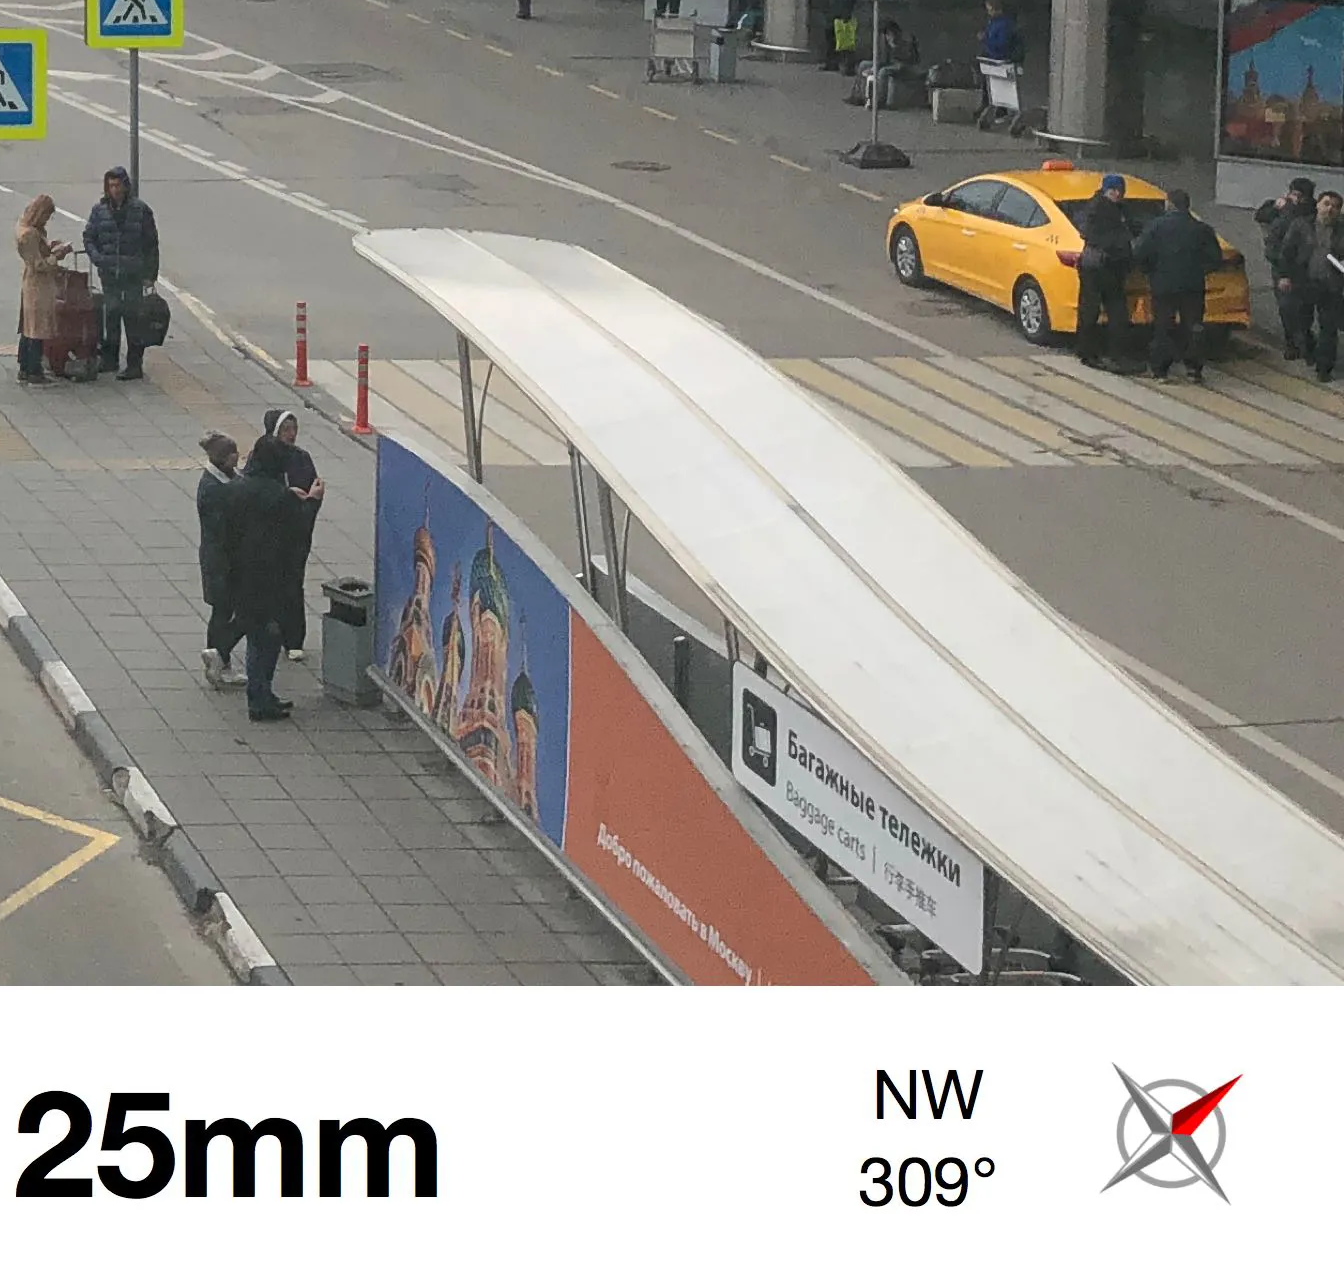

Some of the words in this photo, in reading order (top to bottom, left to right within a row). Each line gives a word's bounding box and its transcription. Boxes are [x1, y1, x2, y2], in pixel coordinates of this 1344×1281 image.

[786, 780, 836, 837] Baggage
[837, 826, 866, 861] carts
[788, 729, 876, 821] Багажные
[878, 804, 961, 888] тележки
[597, 822, 632, 869] Добро
[632, 859, 699, 932] пожаловать
[700, 922, 708, 942] в
[708, 925, 752, 986] Москву
